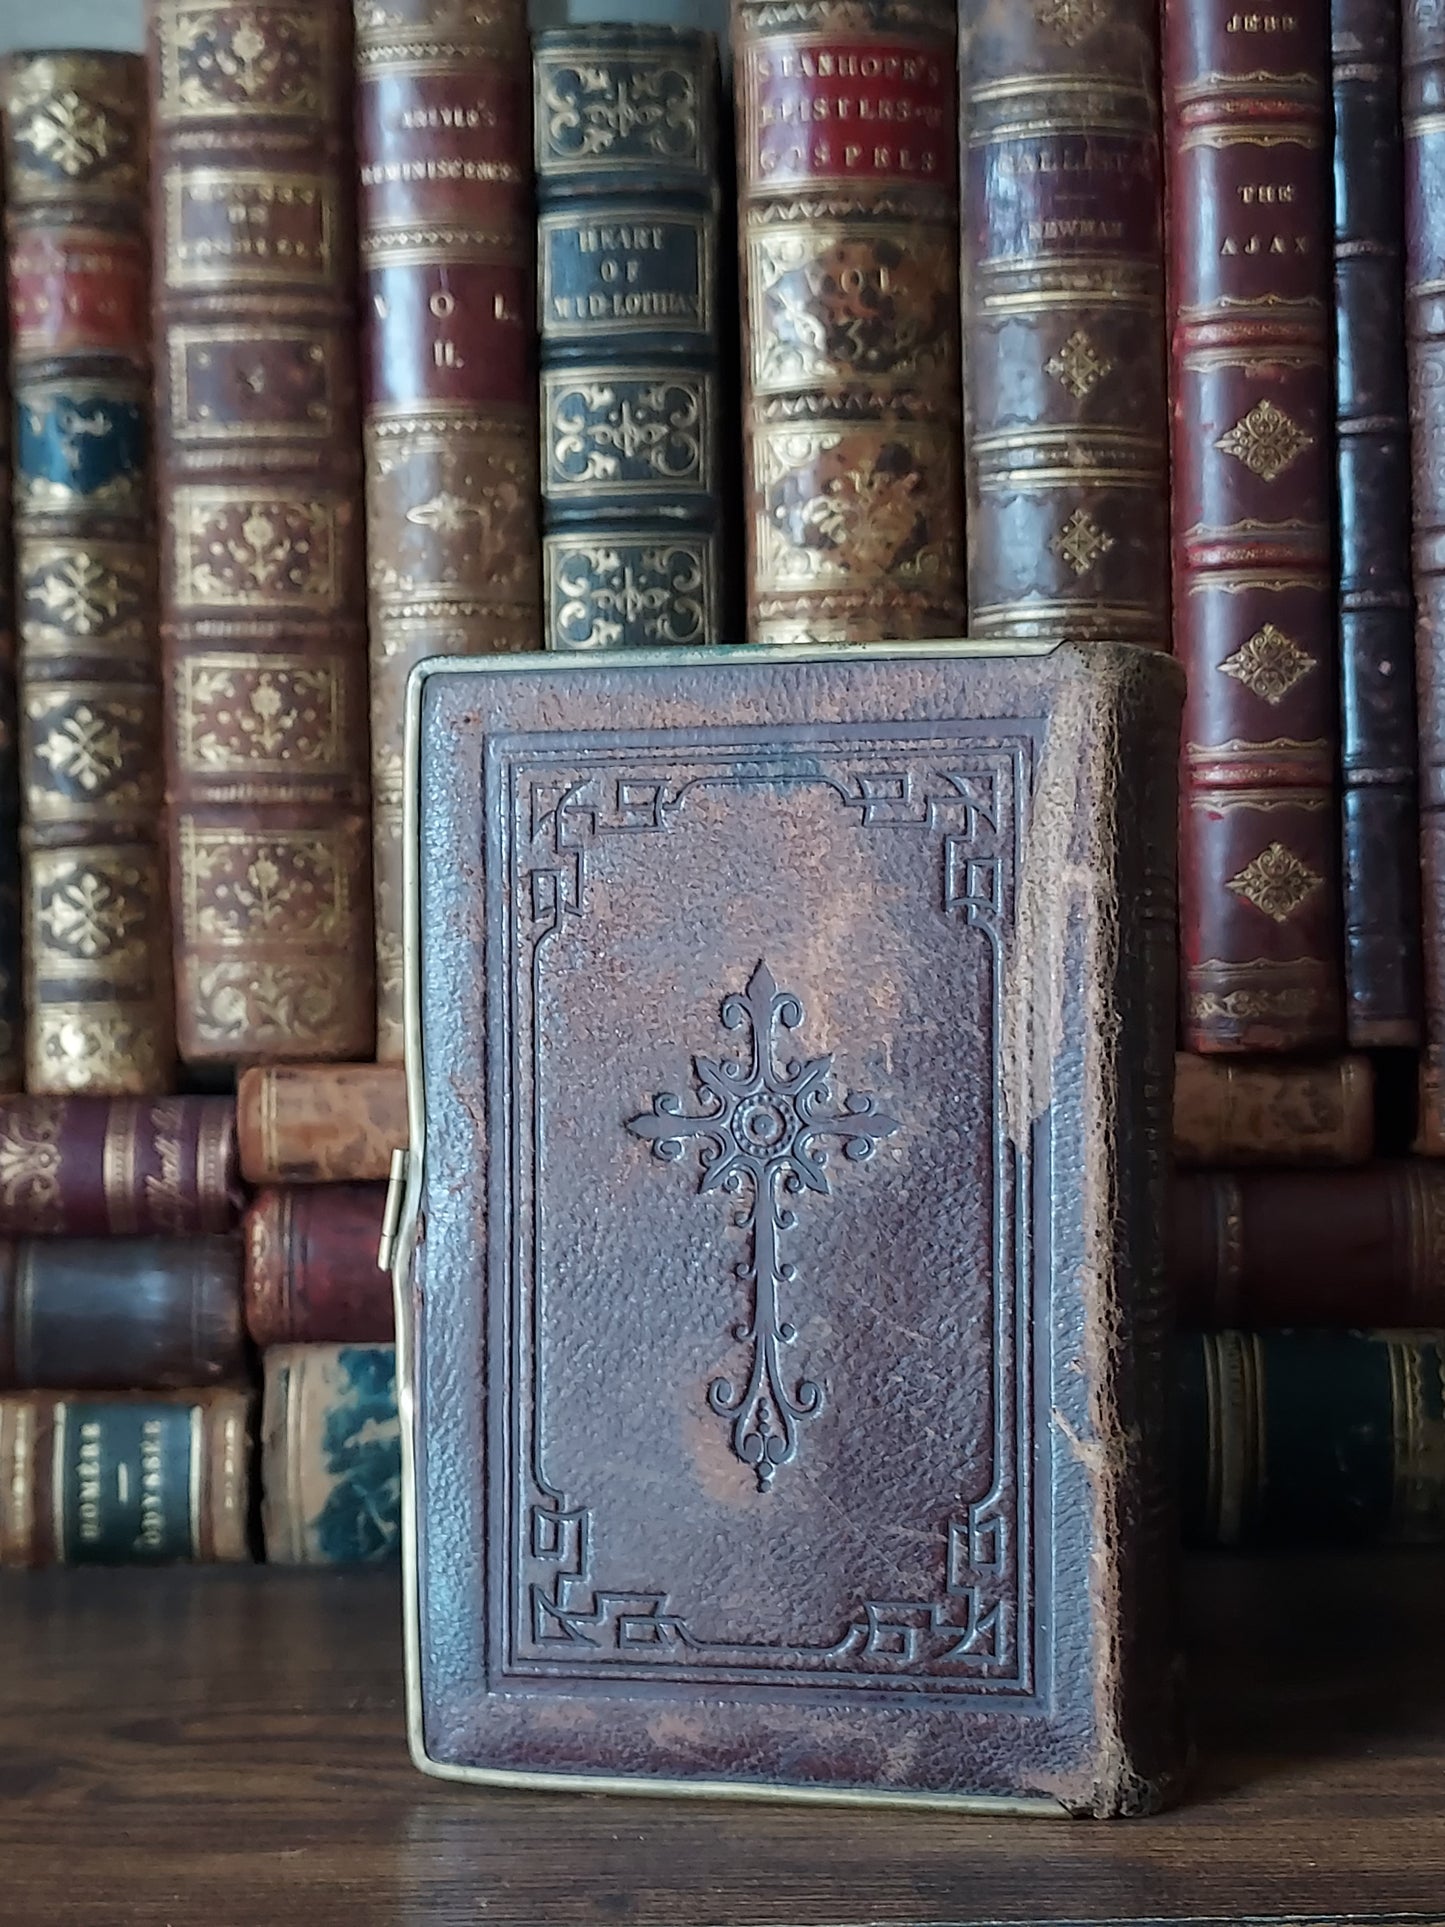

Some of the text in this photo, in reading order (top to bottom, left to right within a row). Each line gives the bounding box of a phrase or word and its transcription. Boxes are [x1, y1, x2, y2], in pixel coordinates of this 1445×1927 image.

[1237, 184, 1294, 203] THE
[1028, 218, 1123, 242] NEWMAN
[1220, 235, 1306, 255] AJAX
[601, 258, 639, 283] OF
